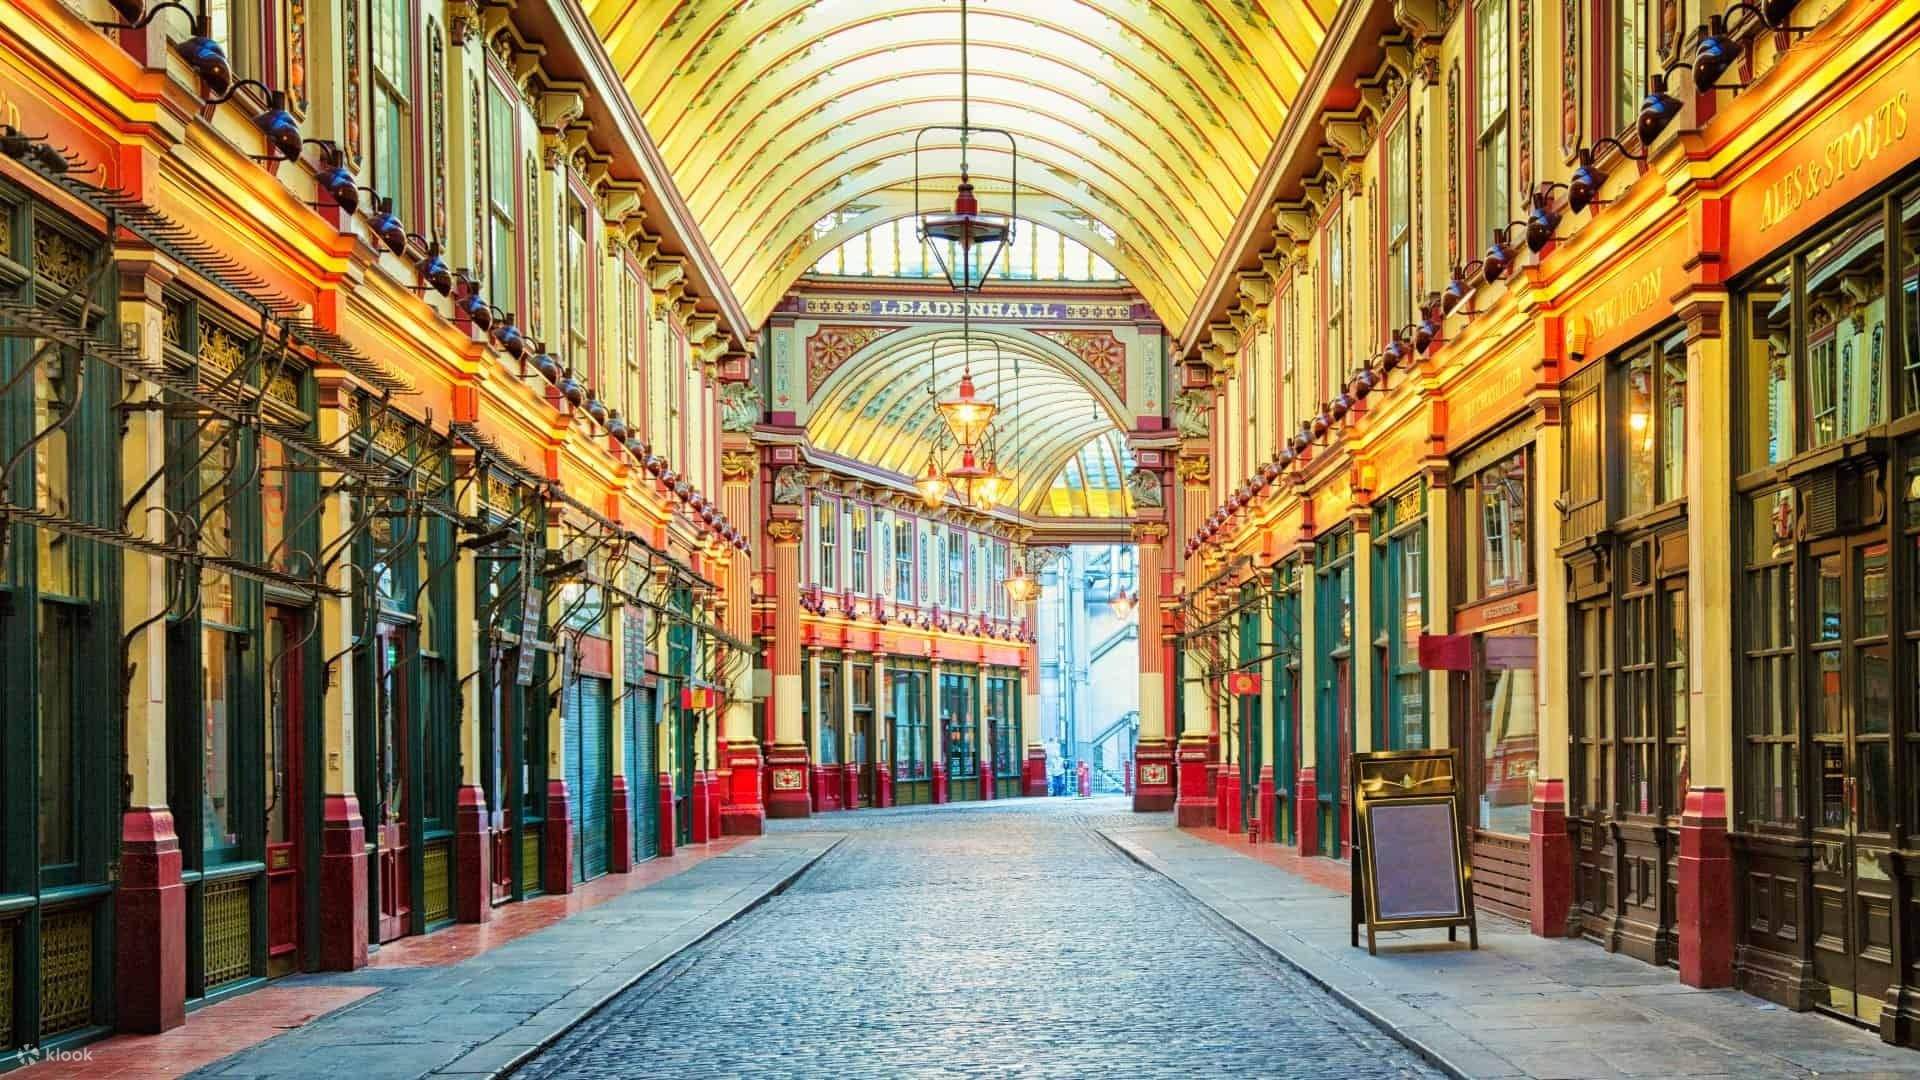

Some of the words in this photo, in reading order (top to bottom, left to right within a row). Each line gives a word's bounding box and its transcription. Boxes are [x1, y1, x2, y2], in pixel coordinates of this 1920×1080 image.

[1760, 163, 1804, 232] ALES
[1806, 160, 1821, 200] &
[1824, 88, 1909, 189] STOUTS
[880, 300, 1057, 318] LEADENHALL
[1616, 266, 1663, 328] MOON
